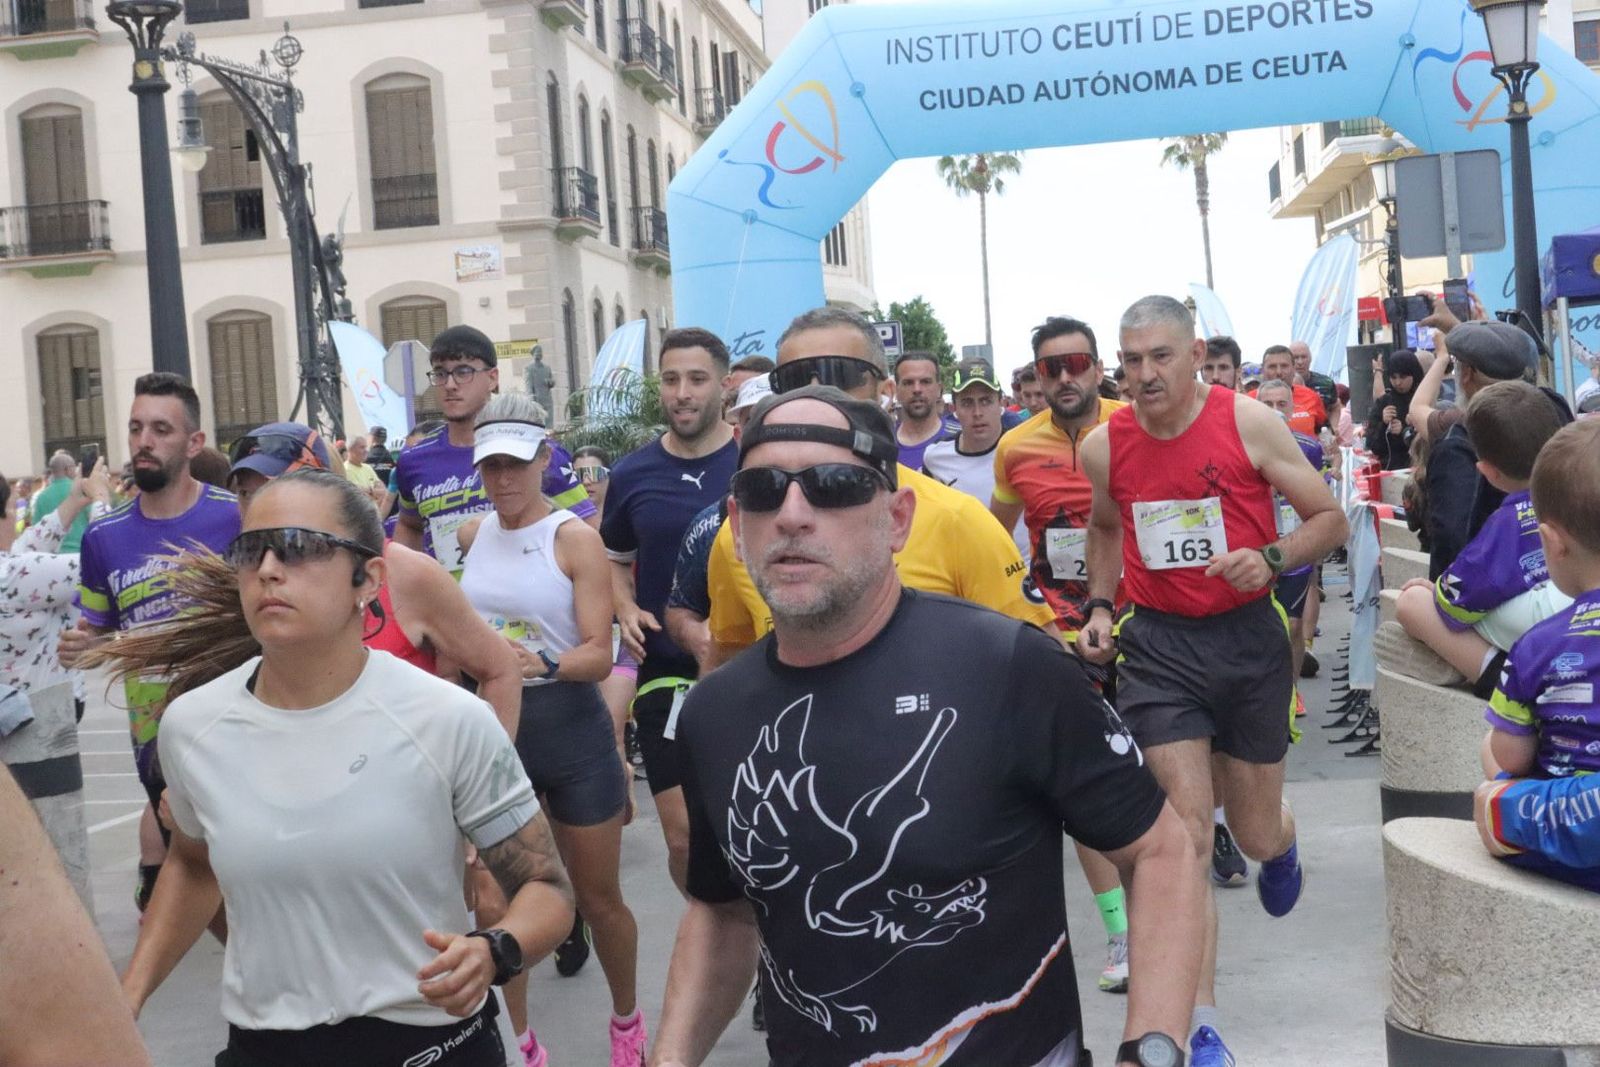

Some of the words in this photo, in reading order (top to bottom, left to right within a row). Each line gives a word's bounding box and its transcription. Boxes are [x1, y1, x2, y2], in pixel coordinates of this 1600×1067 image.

[886, 27, 1042, 65] INSTITUTO
[1052, 12, 1142, 51] CEUTÍ
[1153, 12, 1194, 42] DE
[1204, 0, 1374, 36] DEPORTES
[919, 82, 1025, 111] CIUDAD
[1034, 65, 1196, 103] AUTÓNOMA
[1205, 62, 1243, 86] DE
[1252, 49, 1348, 80] CEUTA
[1164, 538, 1214, 563] 163
[443, 1014, 483, 1052] Kalenji
